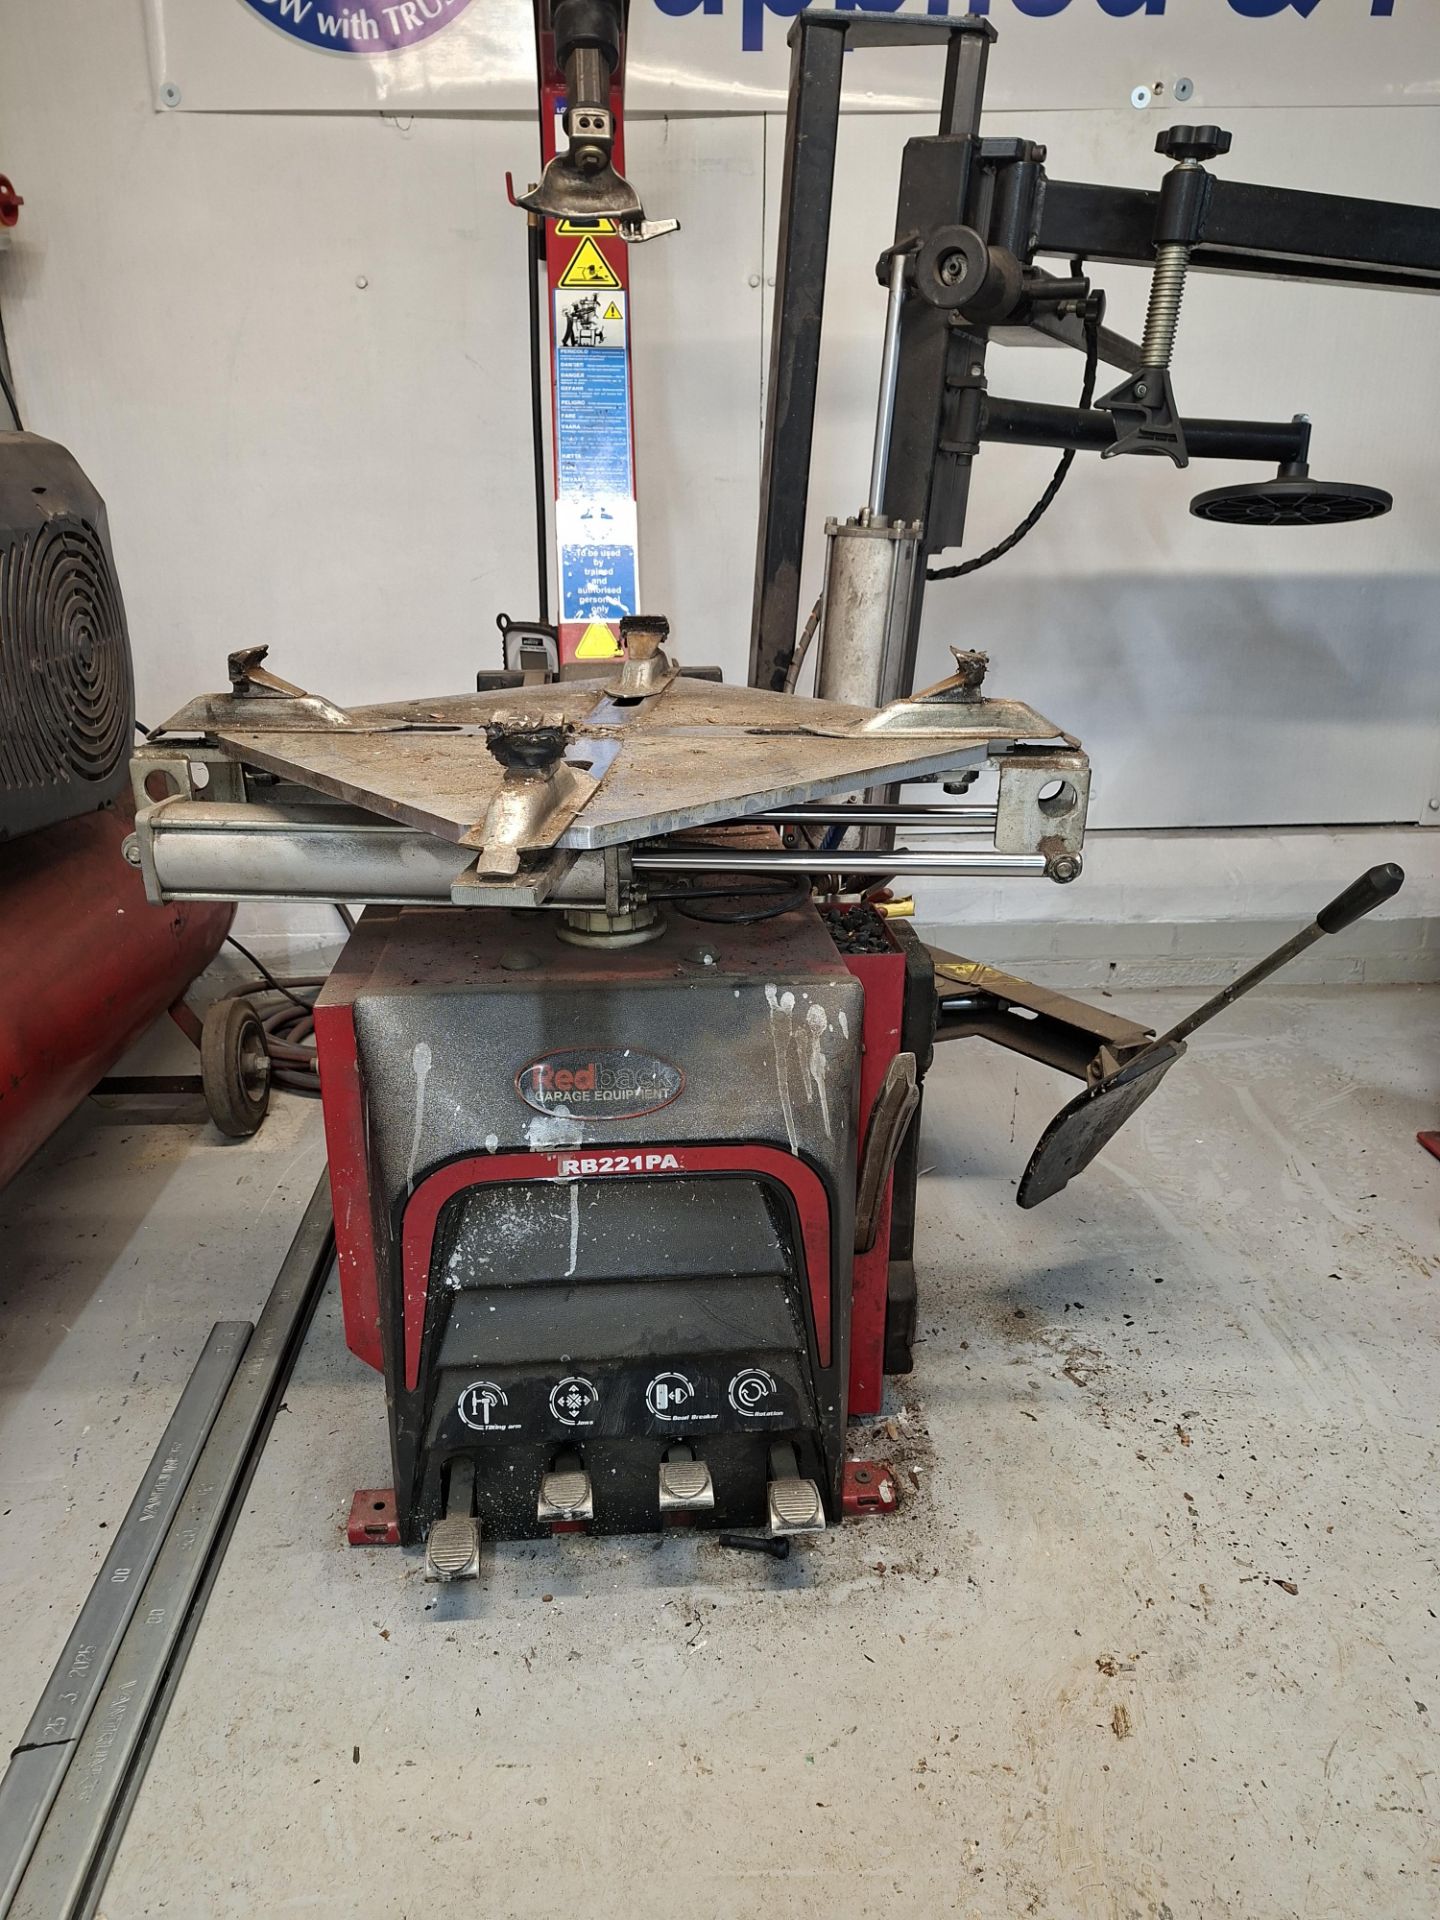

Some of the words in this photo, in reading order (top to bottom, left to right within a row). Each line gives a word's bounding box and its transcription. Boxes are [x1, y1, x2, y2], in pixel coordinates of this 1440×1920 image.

[317, 8, 379, 39] with
[382, 0, 451, 35] TRU
[593, 559, 604, 567] by
[591, 605, 609, 613] only
[531, 1062, 674, 1092] Redback
[534, 1090, 590, 1102] GARAGE
[562, 1153, 679, 1175] RB221PA
